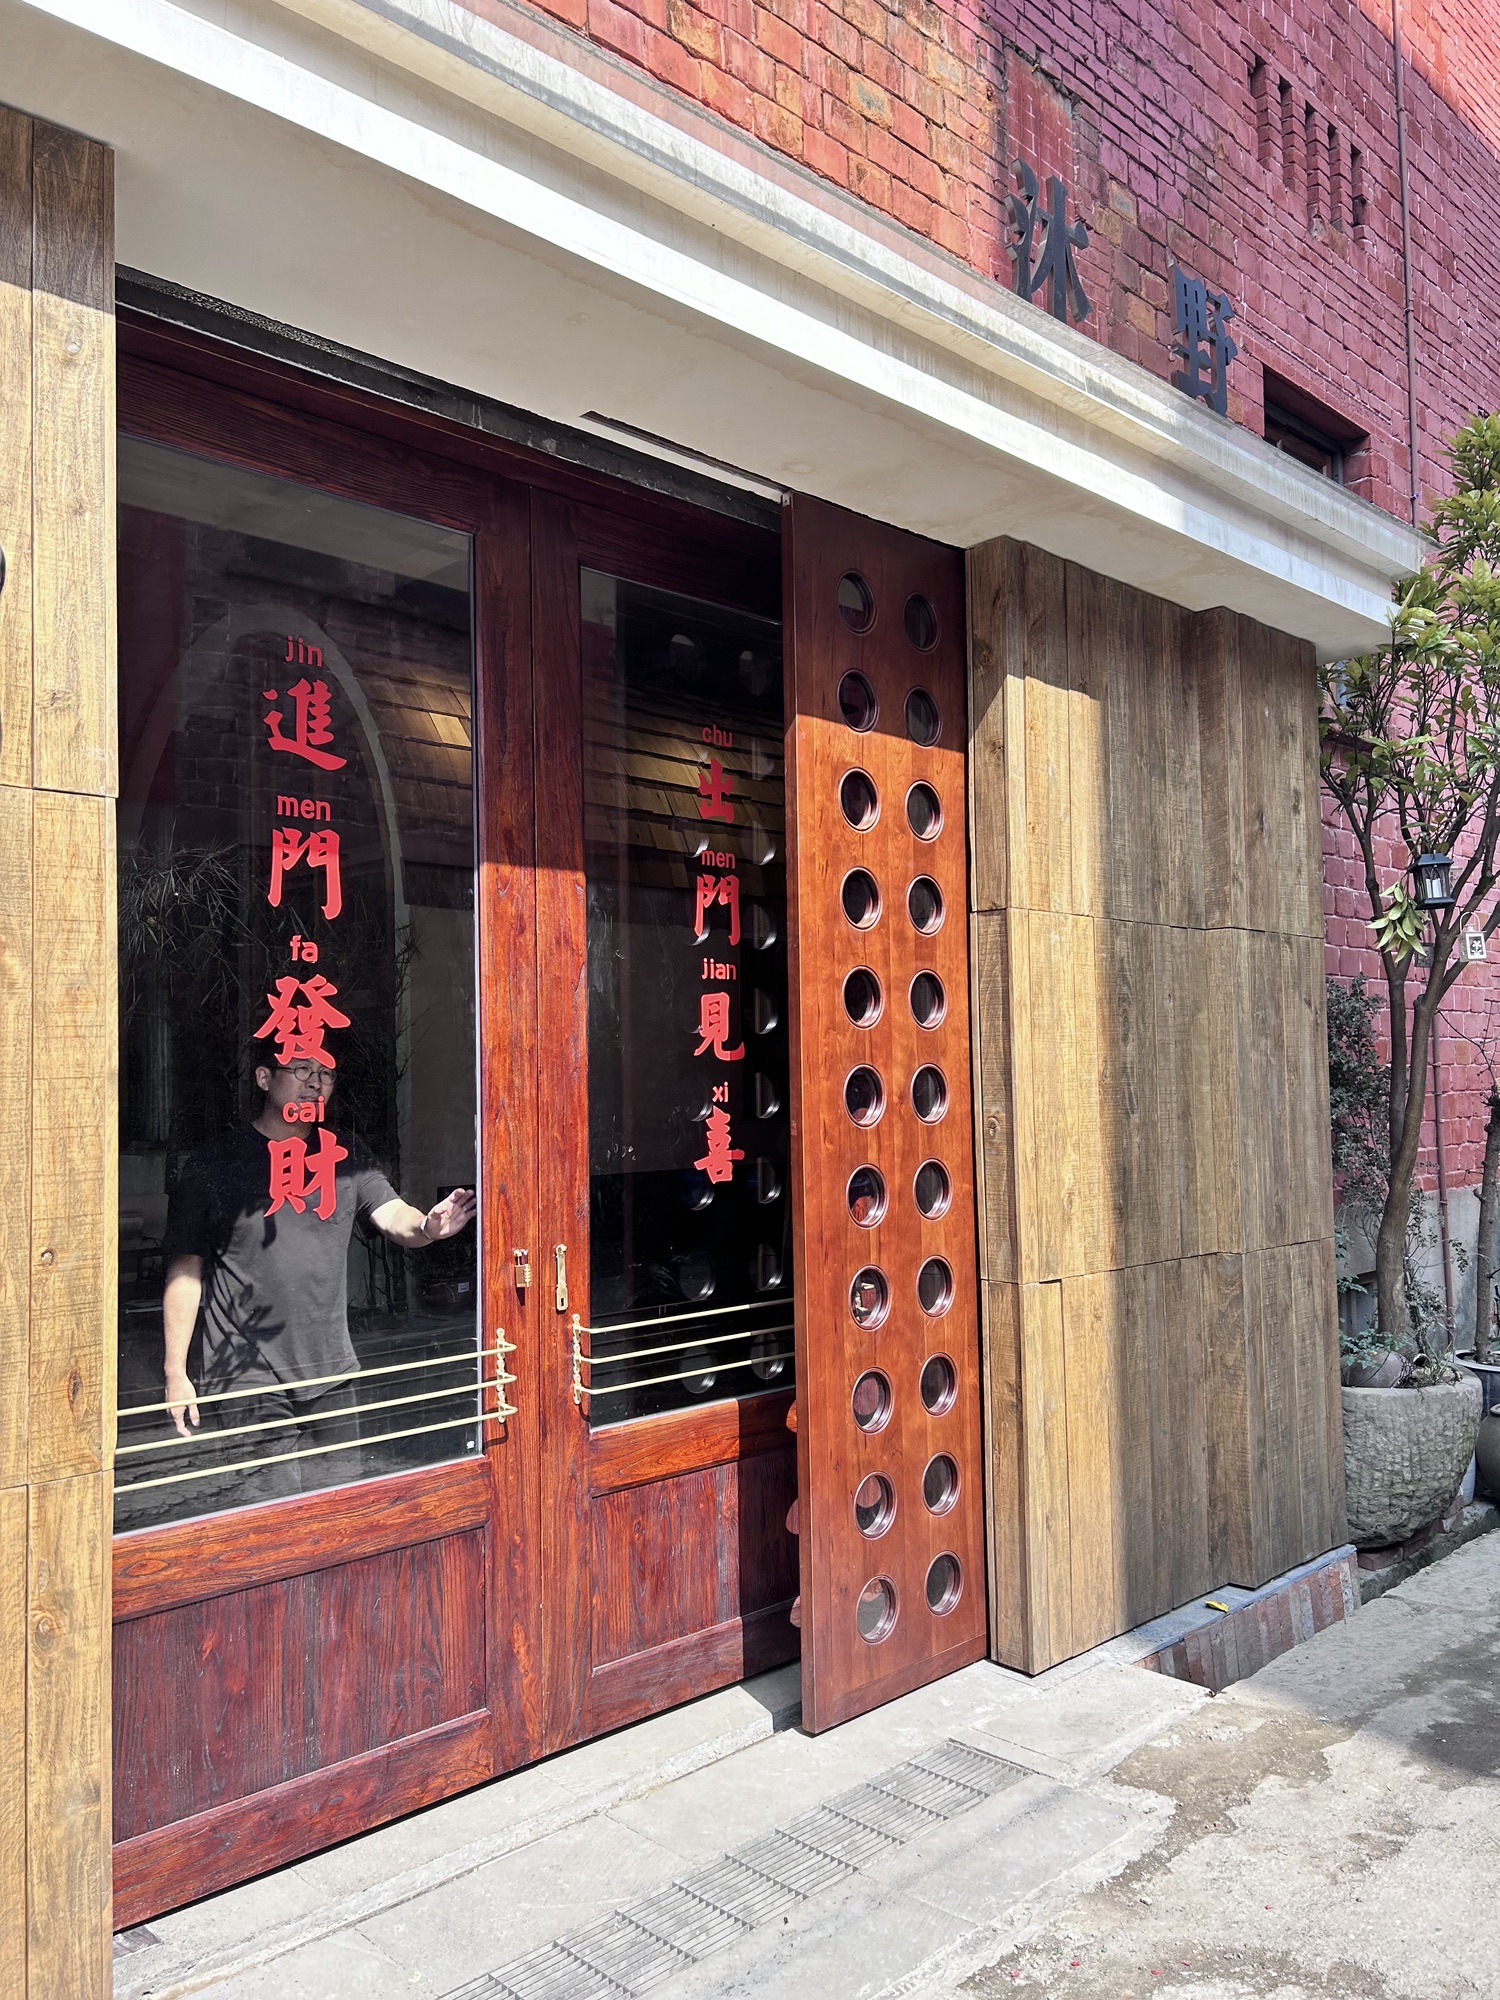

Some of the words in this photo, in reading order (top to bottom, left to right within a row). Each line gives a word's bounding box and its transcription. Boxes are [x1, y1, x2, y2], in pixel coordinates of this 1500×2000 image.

[284, 635, 323, 667] jin
[701, 724, 734, 749] chu
[276, 794, 332, 822] men
[700, 849, 736, 869] men
[289, 934, 320, 963] fa
[700, 957, 737, 981] jian
[711, 1081, 729, 1103] xi
[281, 1094, 326, 1125] cai
